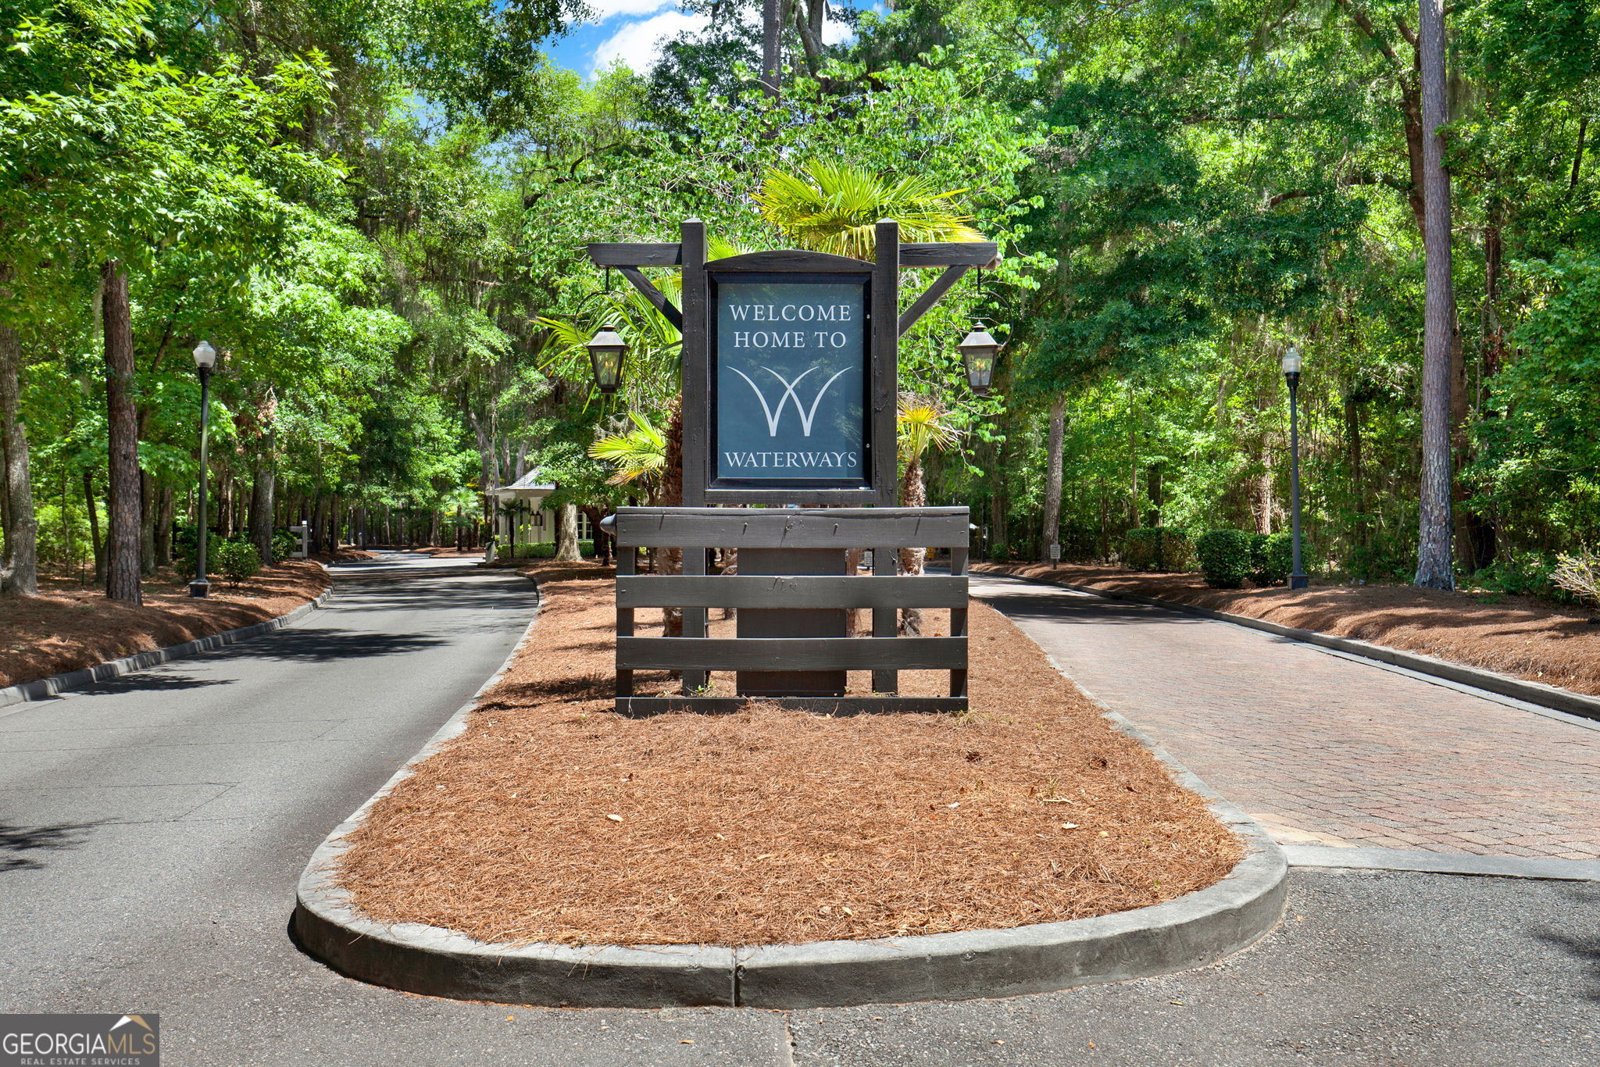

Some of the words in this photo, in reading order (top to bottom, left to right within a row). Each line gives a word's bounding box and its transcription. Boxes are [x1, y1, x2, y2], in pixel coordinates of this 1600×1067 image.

[729, 304, 851, 321] WELCOME
[733, 331, 806, 348] HOME
[814, 331, 847, 348] TO
[724, 451, 857, 468] WATERWAYS
